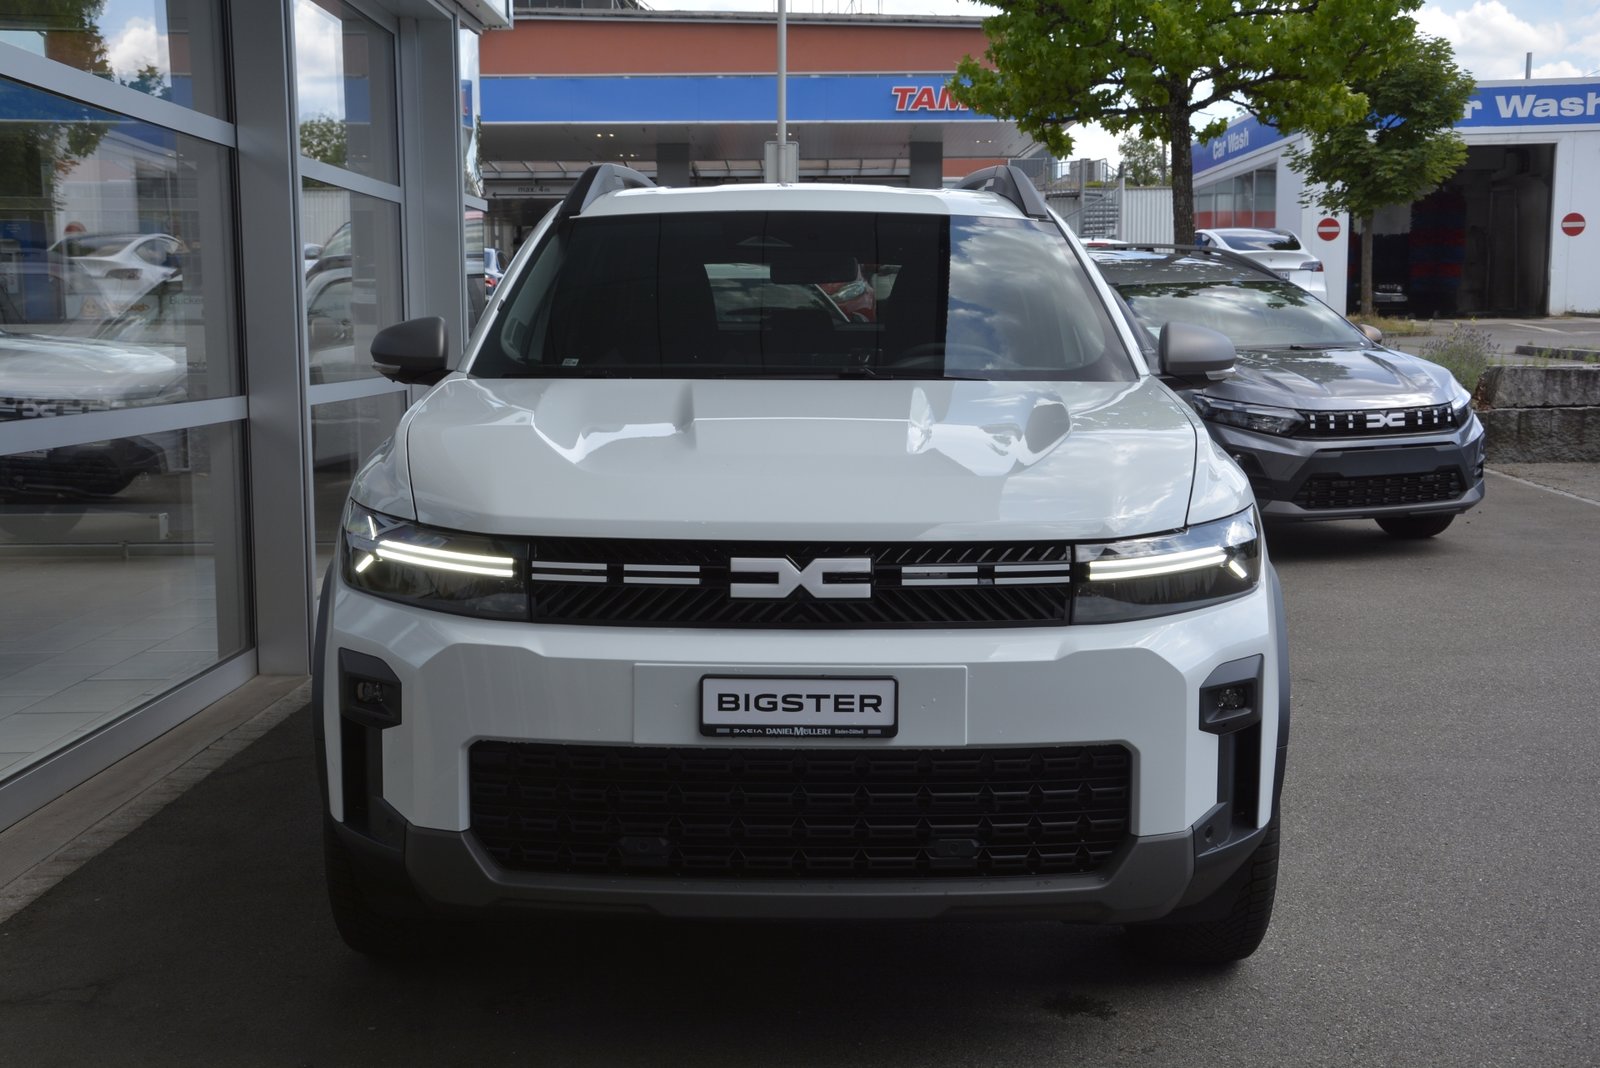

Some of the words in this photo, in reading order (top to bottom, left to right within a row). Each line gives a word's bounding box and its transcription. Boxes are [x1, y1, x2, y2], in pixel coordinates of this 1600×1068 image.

[892, 86, 970, 111] TAM
[1495, 91, 1600, 118] Wash
[1213, 140, 1227, 160] Car
[1227, 127, 1249, 153] Wash
[717, 693, 882, 713] BIGSTER
